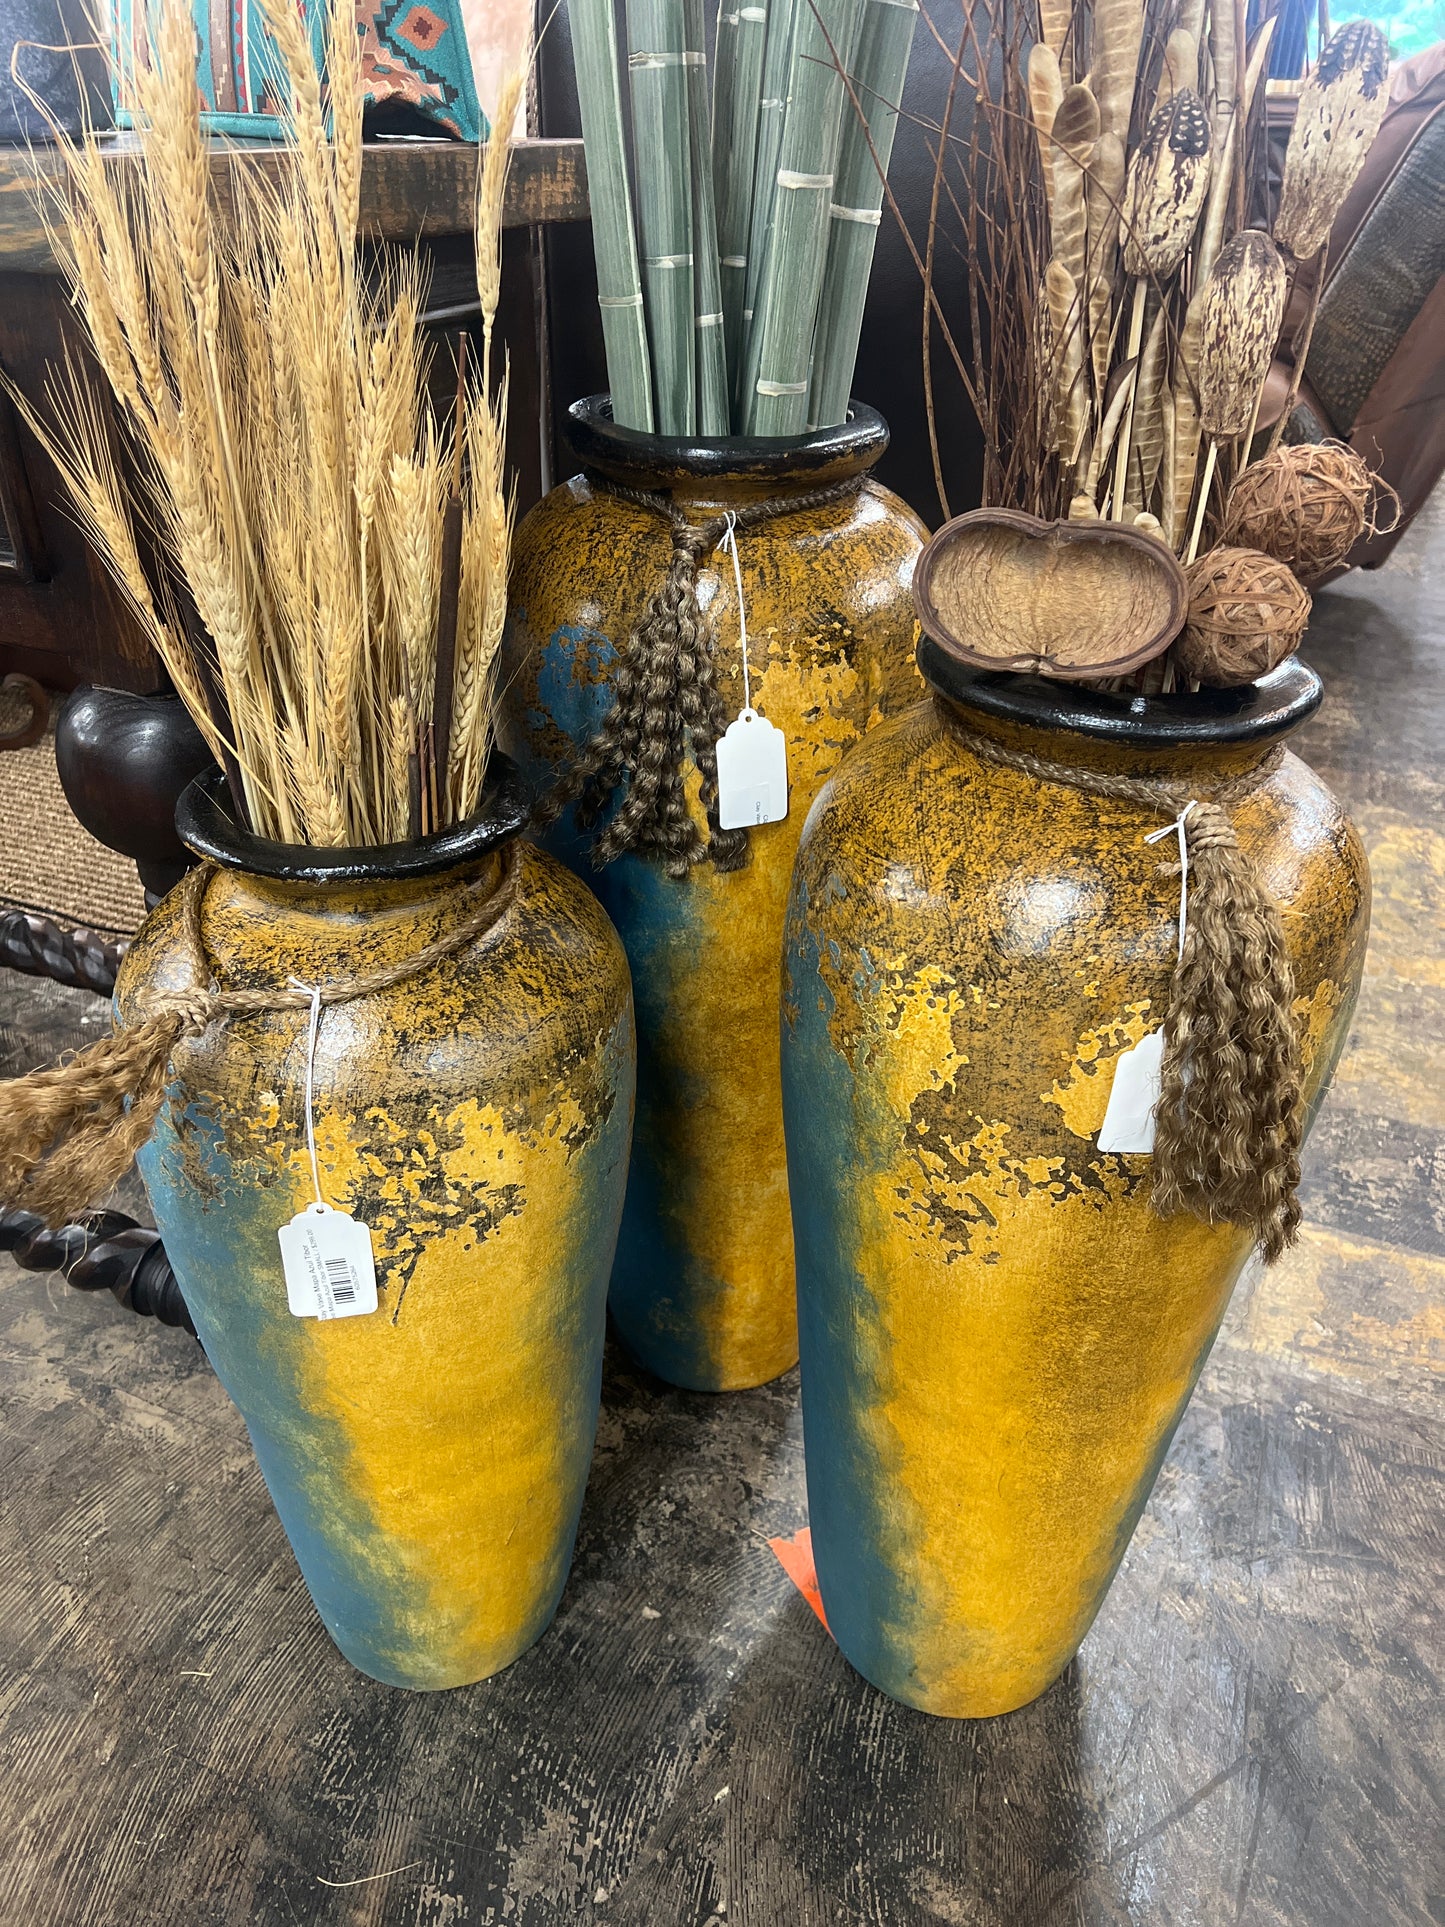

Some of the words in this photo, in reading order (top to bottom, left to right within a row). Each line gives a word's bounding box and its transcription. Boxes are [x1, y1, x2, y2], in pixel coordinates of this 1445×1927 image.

[302, 1244, 311, 1260] Tibor
[306, 1261, 315, 1273] Azul
[314, 1253, 324, 1270] SMALL
[312, 1275, 320, 1292] Mapa
[317, 1293, 325, 1309] Vase
[327, 1297, 335, 1312] Mapa
